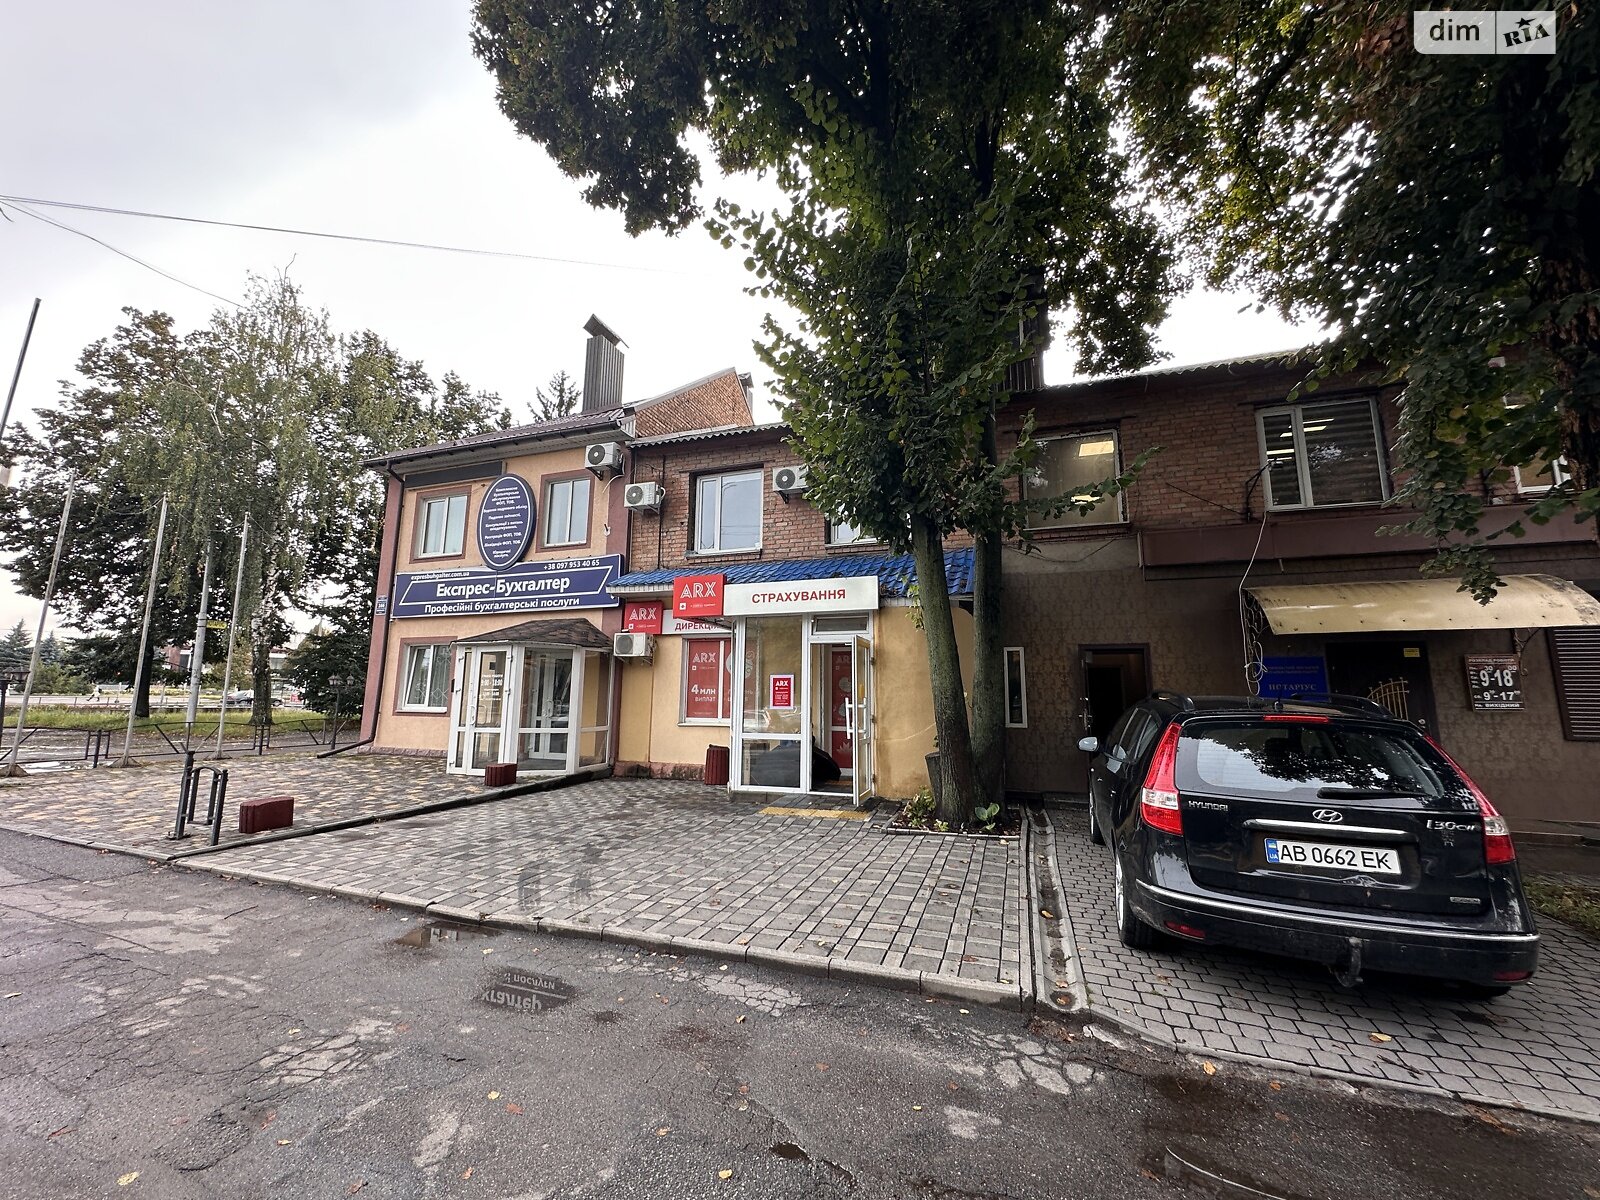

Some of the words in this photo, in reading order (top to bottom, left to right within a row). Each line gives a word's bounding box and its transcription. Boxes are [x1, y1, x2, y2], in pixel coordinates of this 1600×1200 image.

[436, 576, 571, 599] Експрес-Бухгалтер
[679, 581, 717, 599] ARX
[751, 588, 846, 604] СТРАХУВАННЯ
[424, 602, 473, 615] Професійні
[474, 598, 538, 613] бухгалтерські
[540, 598, 580, 609] послуги
[628, 607, 657, 621] ARX
[692, 652, 716, 663] ARX
[691, 683, 699, 695] 4
[1188, 800, 1228, 811] HYUNDAI
[1280, 844, 1307, 862] AB
[1311, 847, 1358, 867] 0662
[1361, 850, 1392, 870] EK
